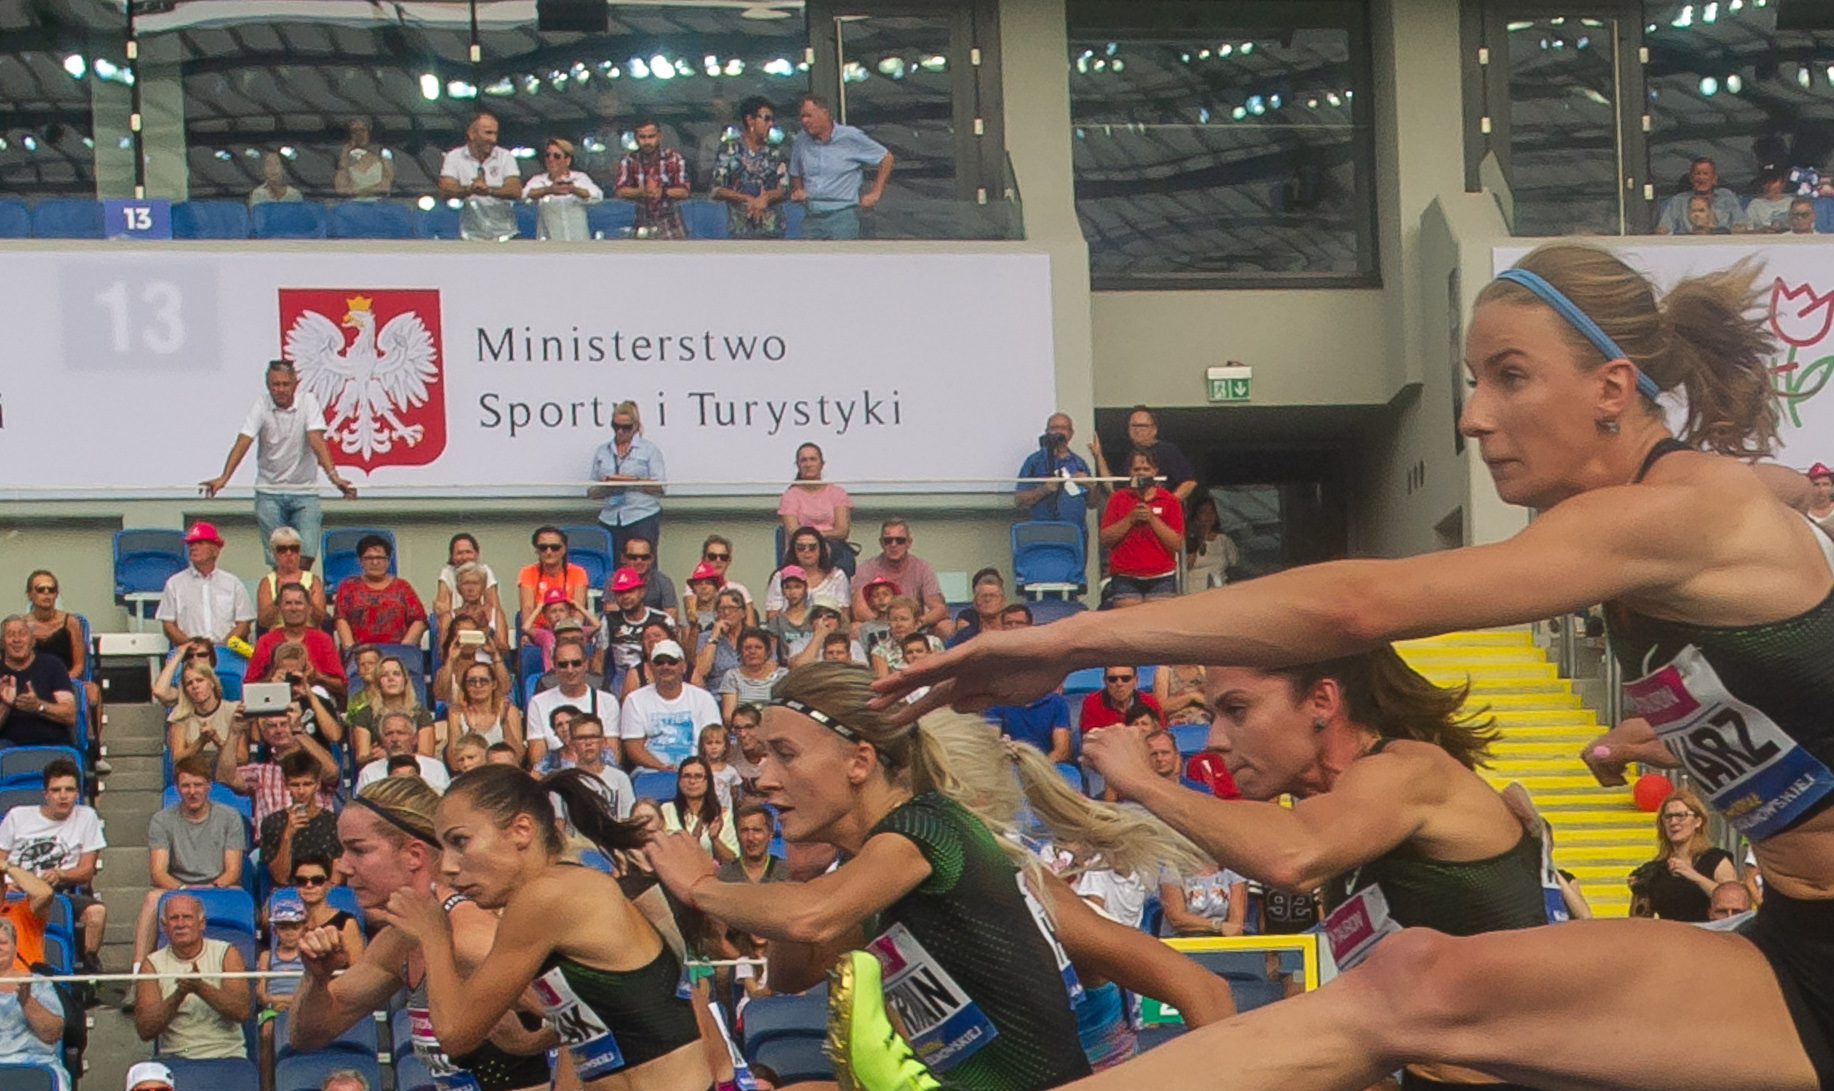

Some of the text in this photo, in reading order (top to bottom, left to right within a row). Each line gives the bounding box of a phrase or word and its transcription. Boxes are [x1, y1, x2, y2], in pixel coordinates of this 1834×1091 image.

[123, 207, 152, 230] 13
[94, 278, 187, 354] 13
[475, 326, 787, 362] Ministerstwo
[478, 390, 902, 438] Sport i Turystyki
